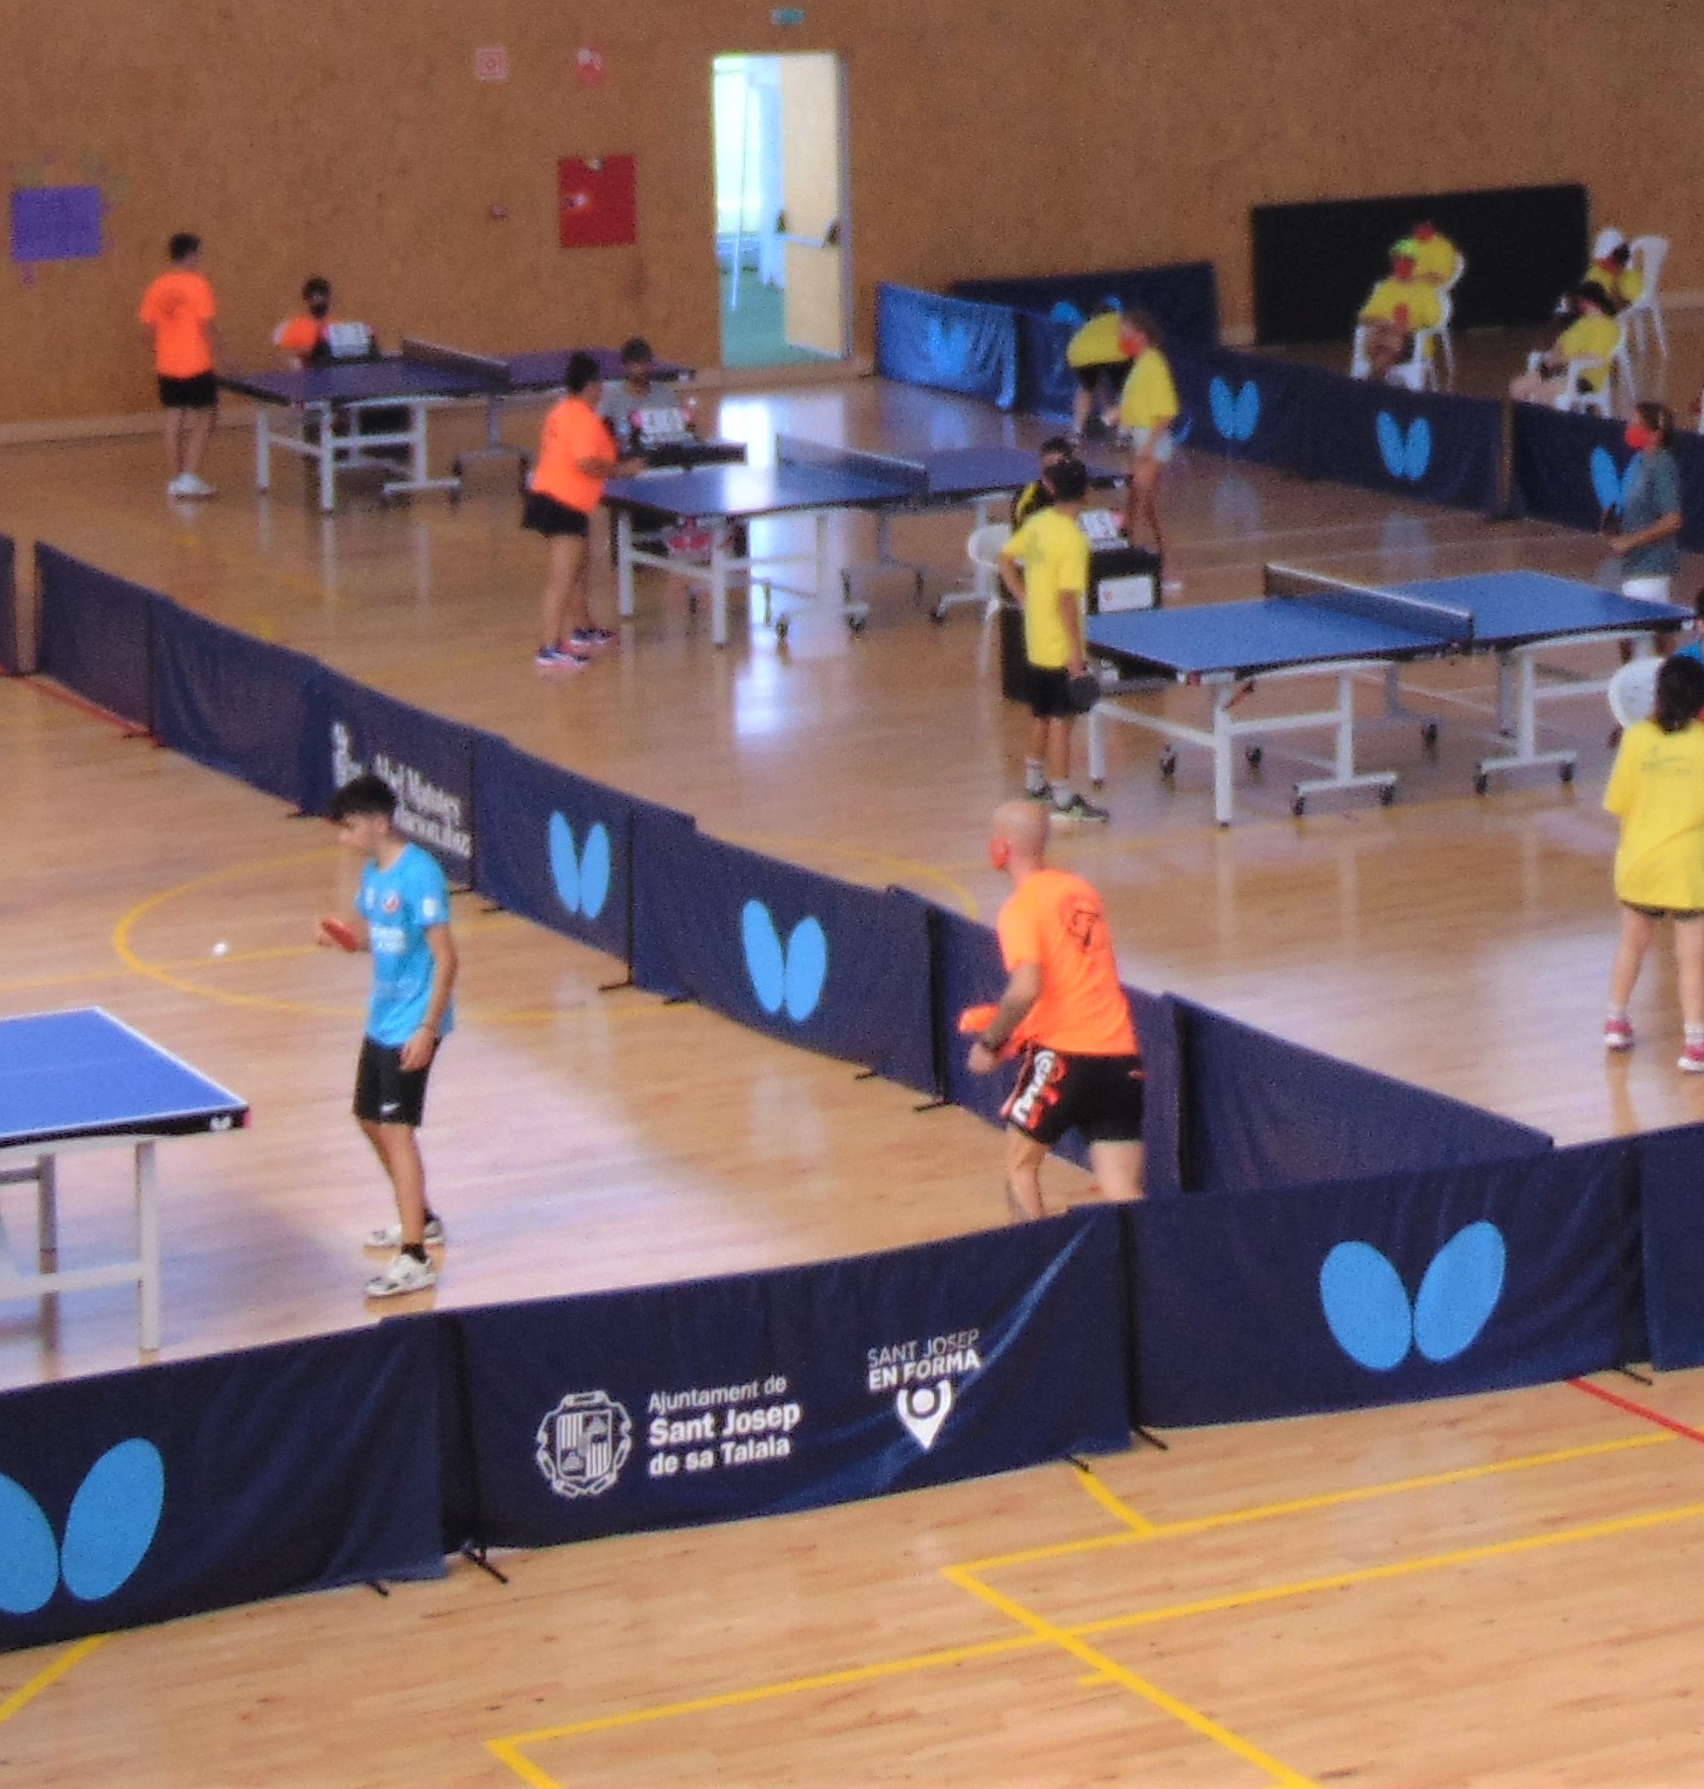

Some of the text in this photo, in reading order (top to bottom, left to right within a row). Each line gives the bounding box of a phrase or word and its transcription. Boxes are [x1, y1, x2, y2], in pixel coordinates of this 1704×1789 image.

[867, 1328, 979, 1368] SANT JOSEP
[868, 1348, 981, 1391] EN FORMA
[648, 1374, 788, 1415] Ajuntament de
[649, 1402, 802, 1447] Sant Josep
[649, 1435, 791, 1477] de sa Talaia
